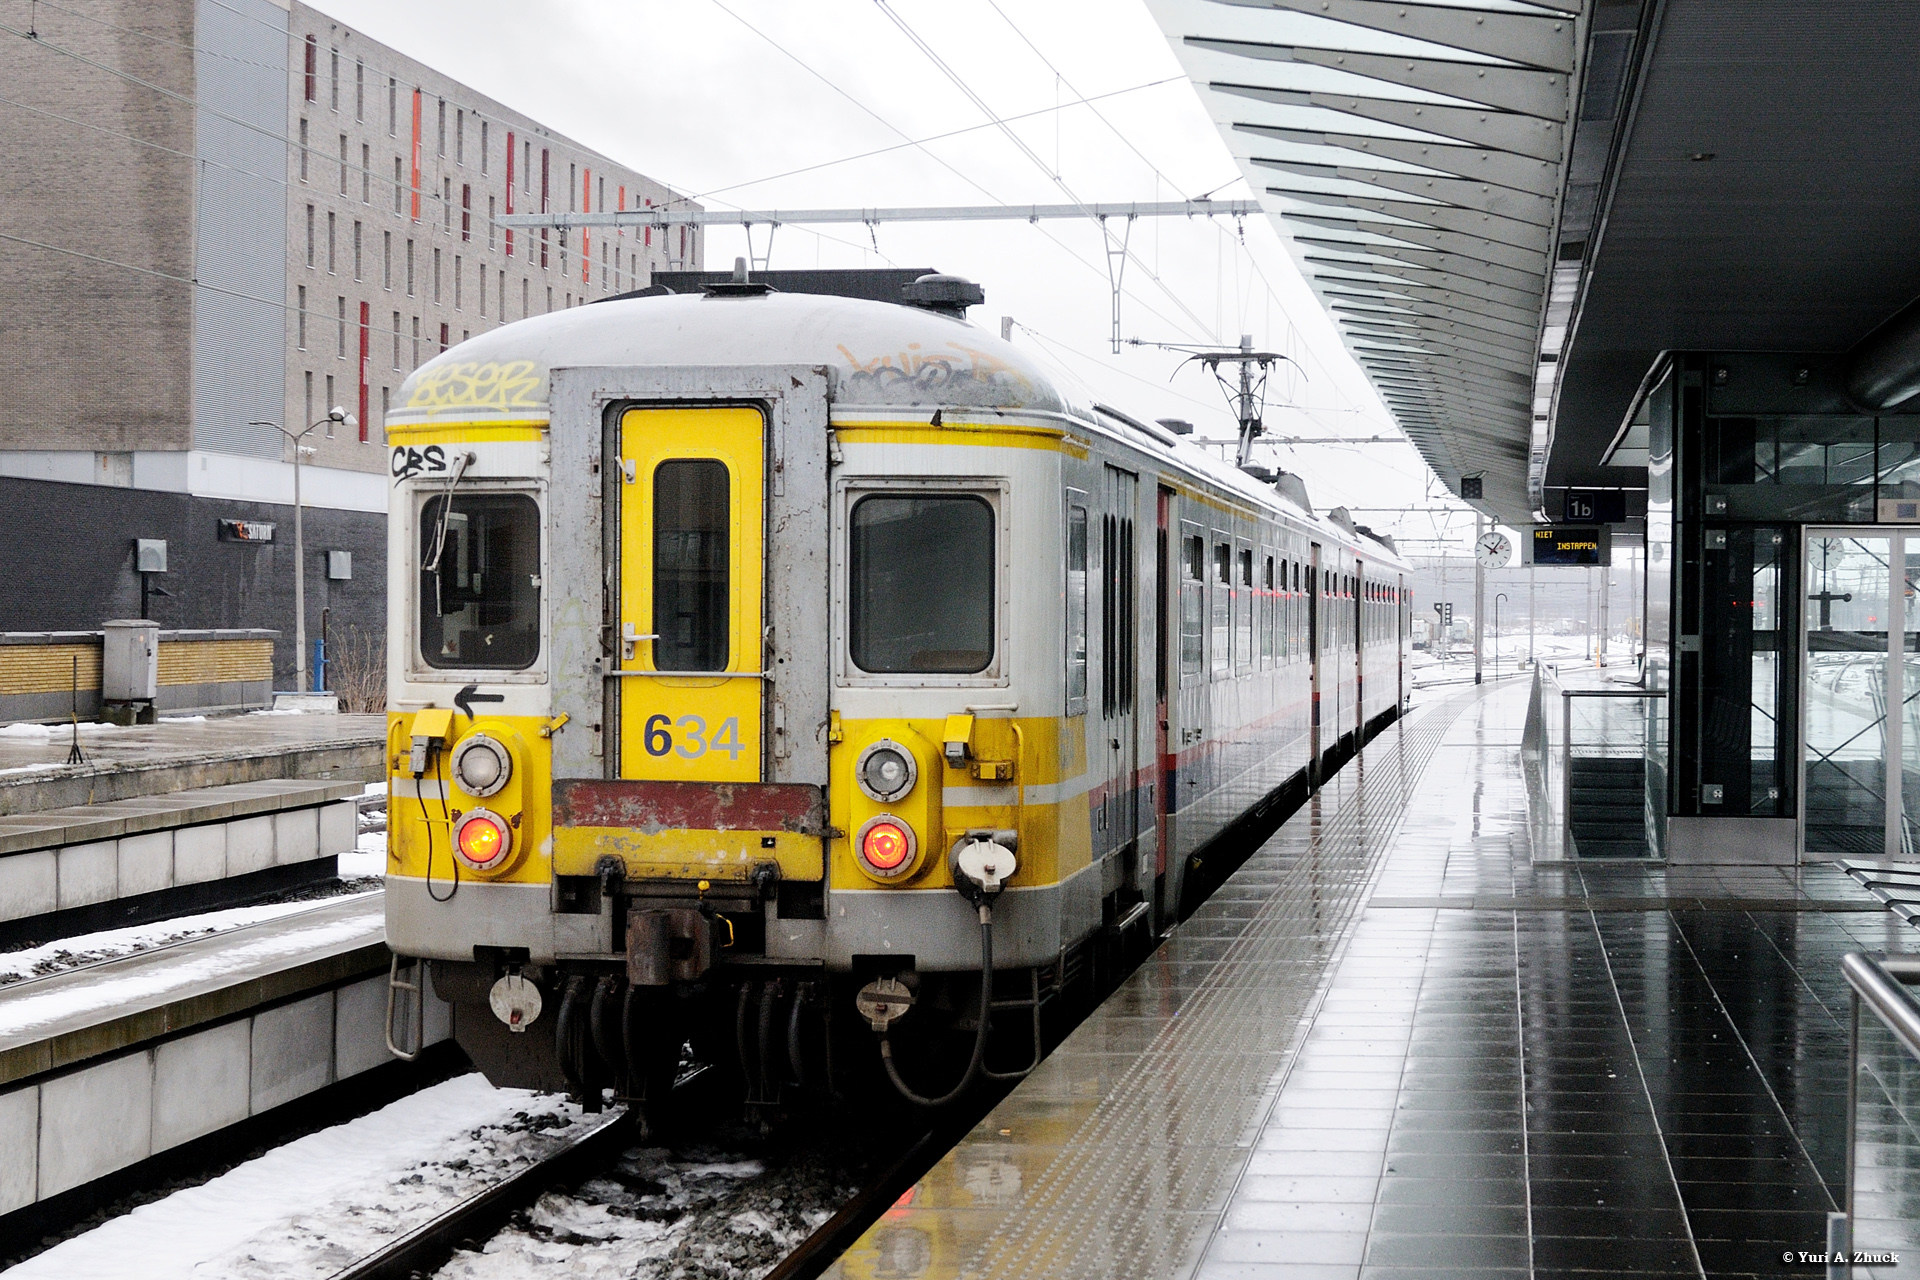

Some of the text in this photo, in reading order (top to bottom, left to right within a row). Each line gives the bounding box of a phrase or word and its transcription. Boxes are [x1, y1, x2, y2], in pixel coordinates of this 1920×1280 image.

[1571, 500, 1592, 517] 1b
[1535, 530, 1553, 539] NIET
[1557, 542, 1597, 551] INSTAPPEN
[643, 713, 746, 761] 634
